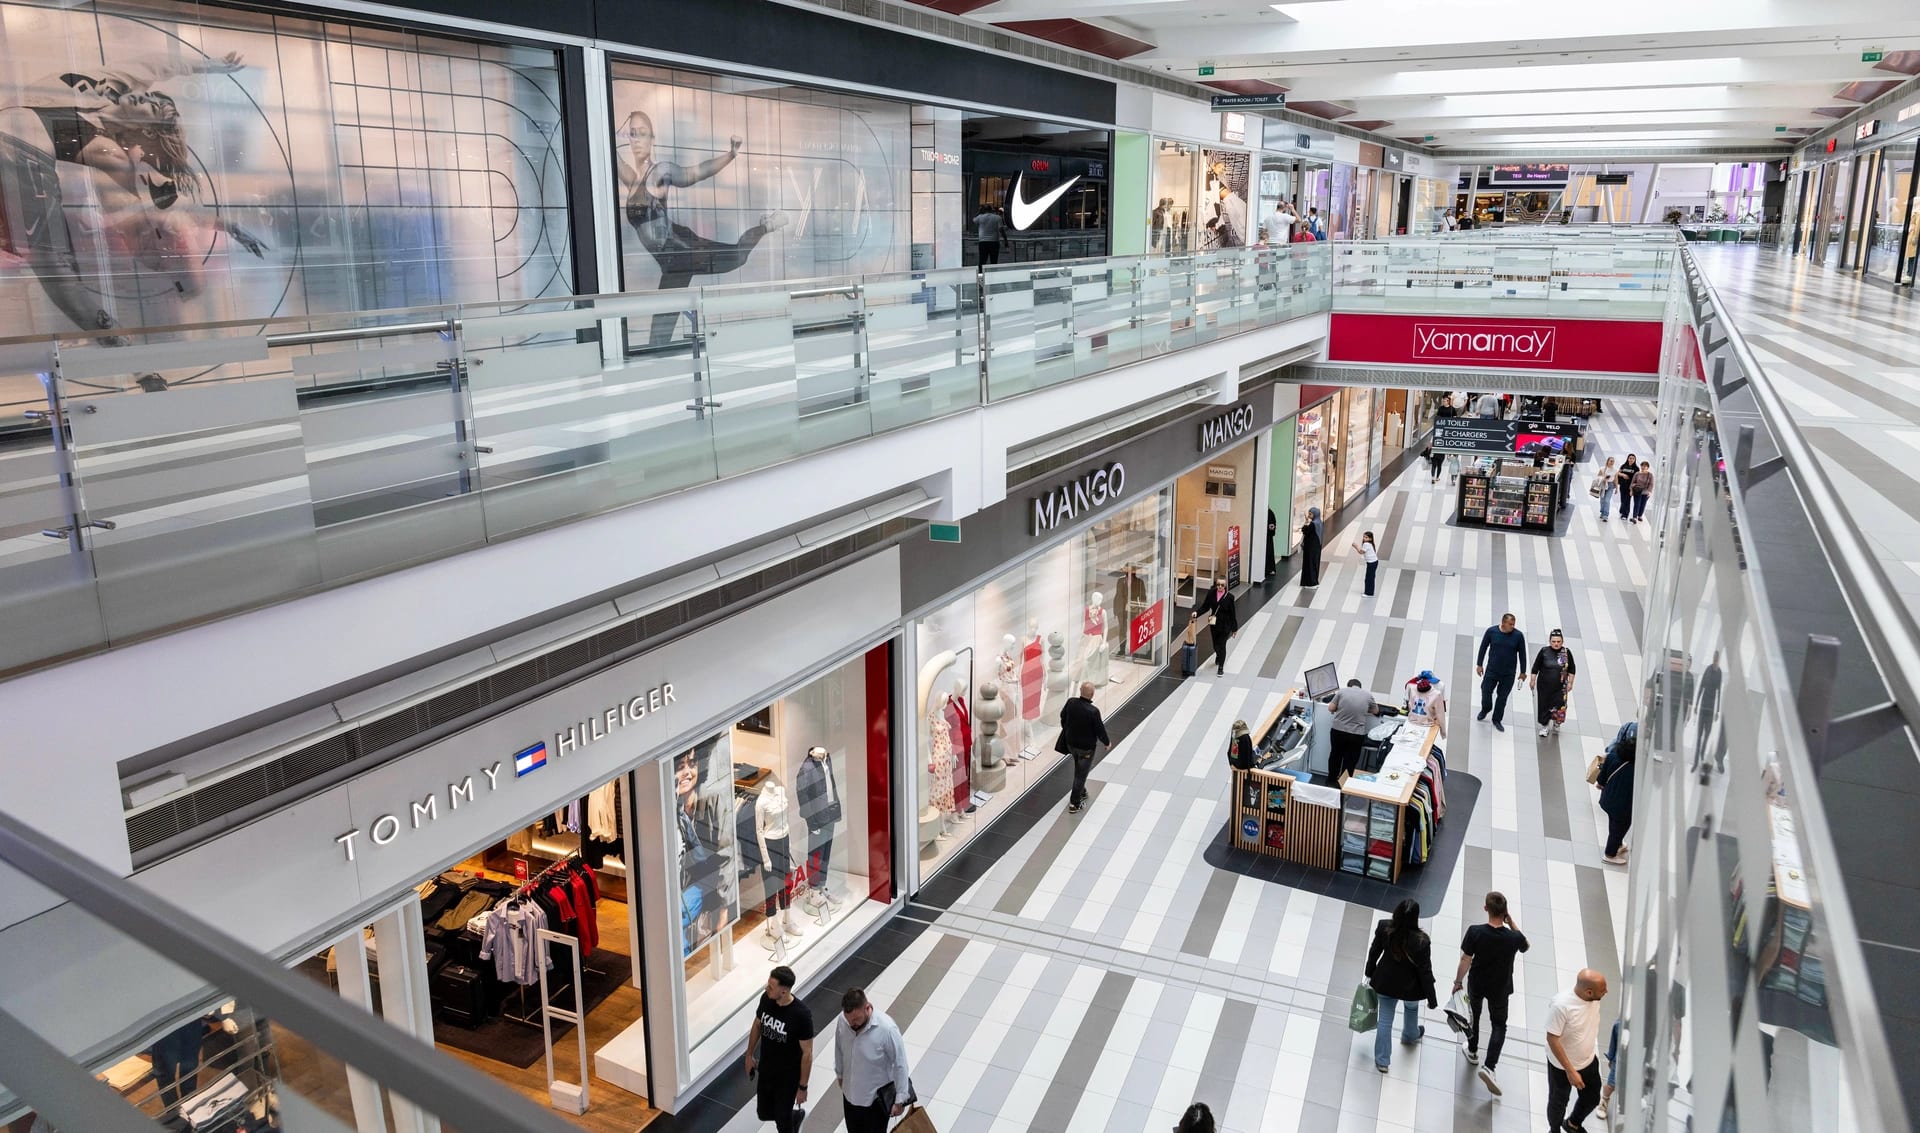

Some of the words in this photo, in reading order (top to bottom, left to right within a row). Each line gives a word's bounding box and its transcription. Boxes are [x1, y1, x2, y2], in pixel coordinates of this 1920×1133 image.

[1418, 327, 1552, 357] yamamay
[1202, 404, 1254, 452] MANGO
[1445, 430, 1488, 439] E-CHARGERS
[1445, 440, 1476, 448] LOCKERS
[1034, 462, 1125, 536] MANGO
[335, 761, 501, 861] TOMMY
[556, 682, 677, 757] HILFIGER
[784, 851, 821, 894] SALE
[760, 1012, 788, 1035] KARL
